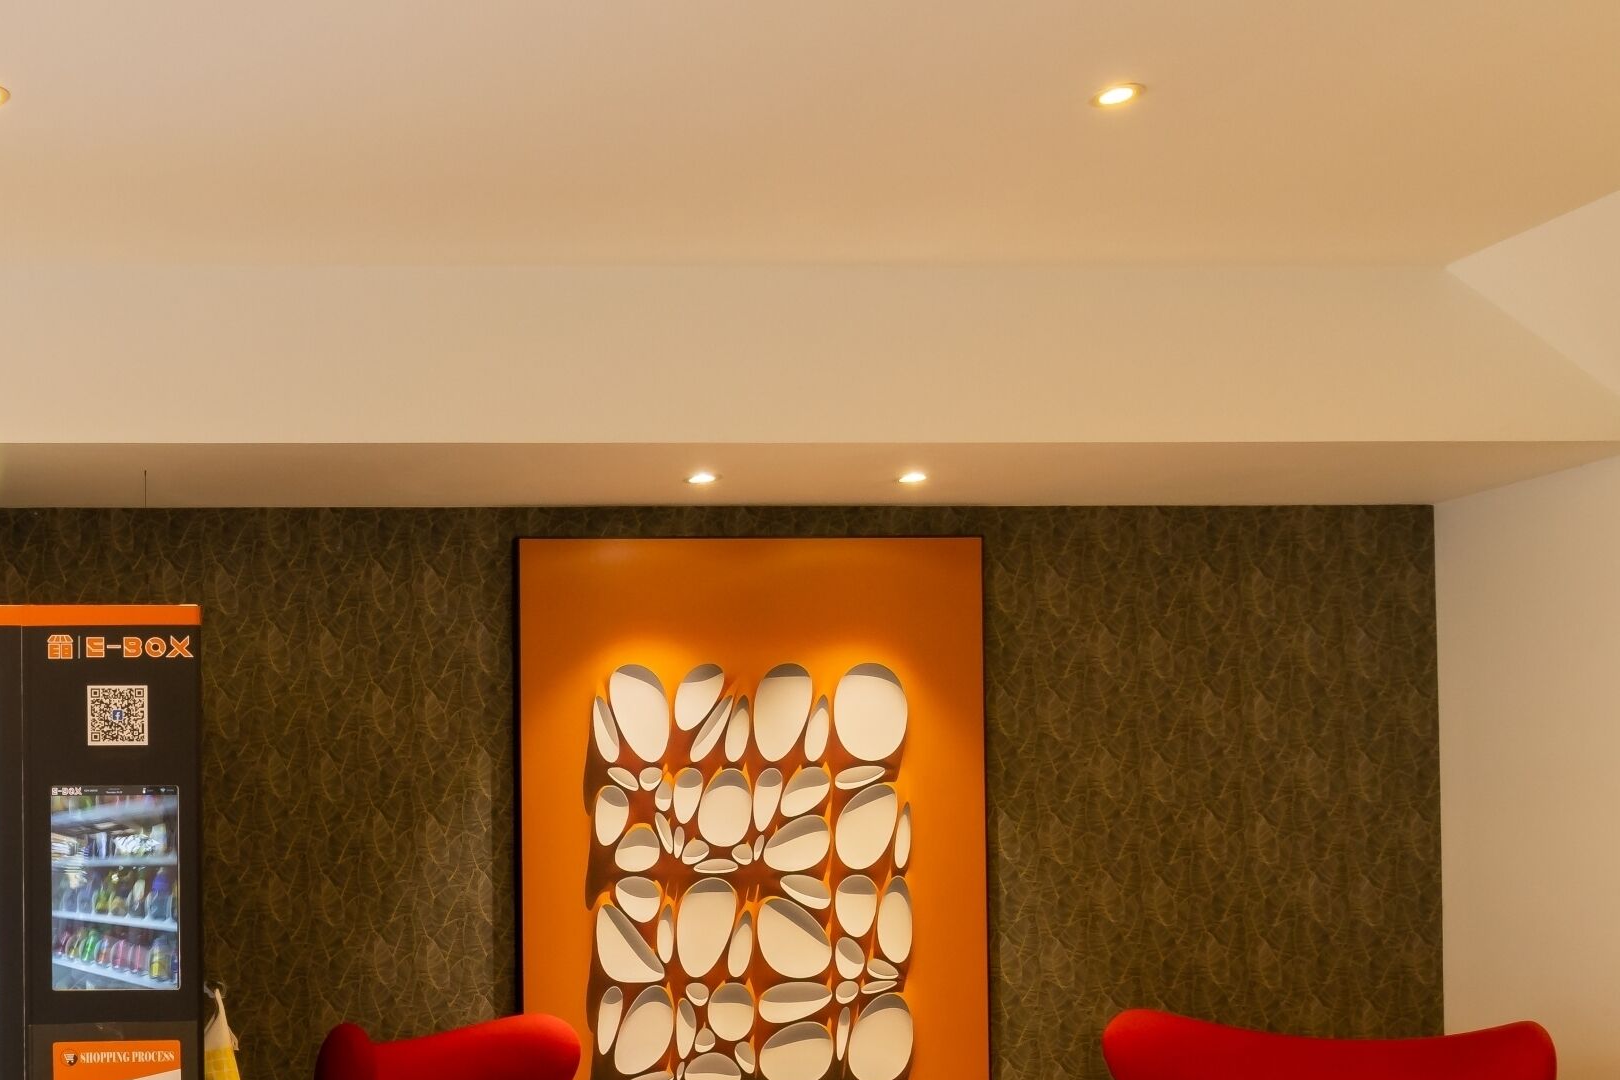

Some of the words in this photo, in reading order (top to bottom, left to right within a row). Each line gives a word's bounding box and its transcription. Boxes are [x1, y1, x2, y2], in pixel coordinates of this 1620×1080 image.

[86, 635, 194, 658] E-BOX
[80, 1050, 130, 1063] SHOPPING
[132, 1050, 175, 1062] PROCESS
